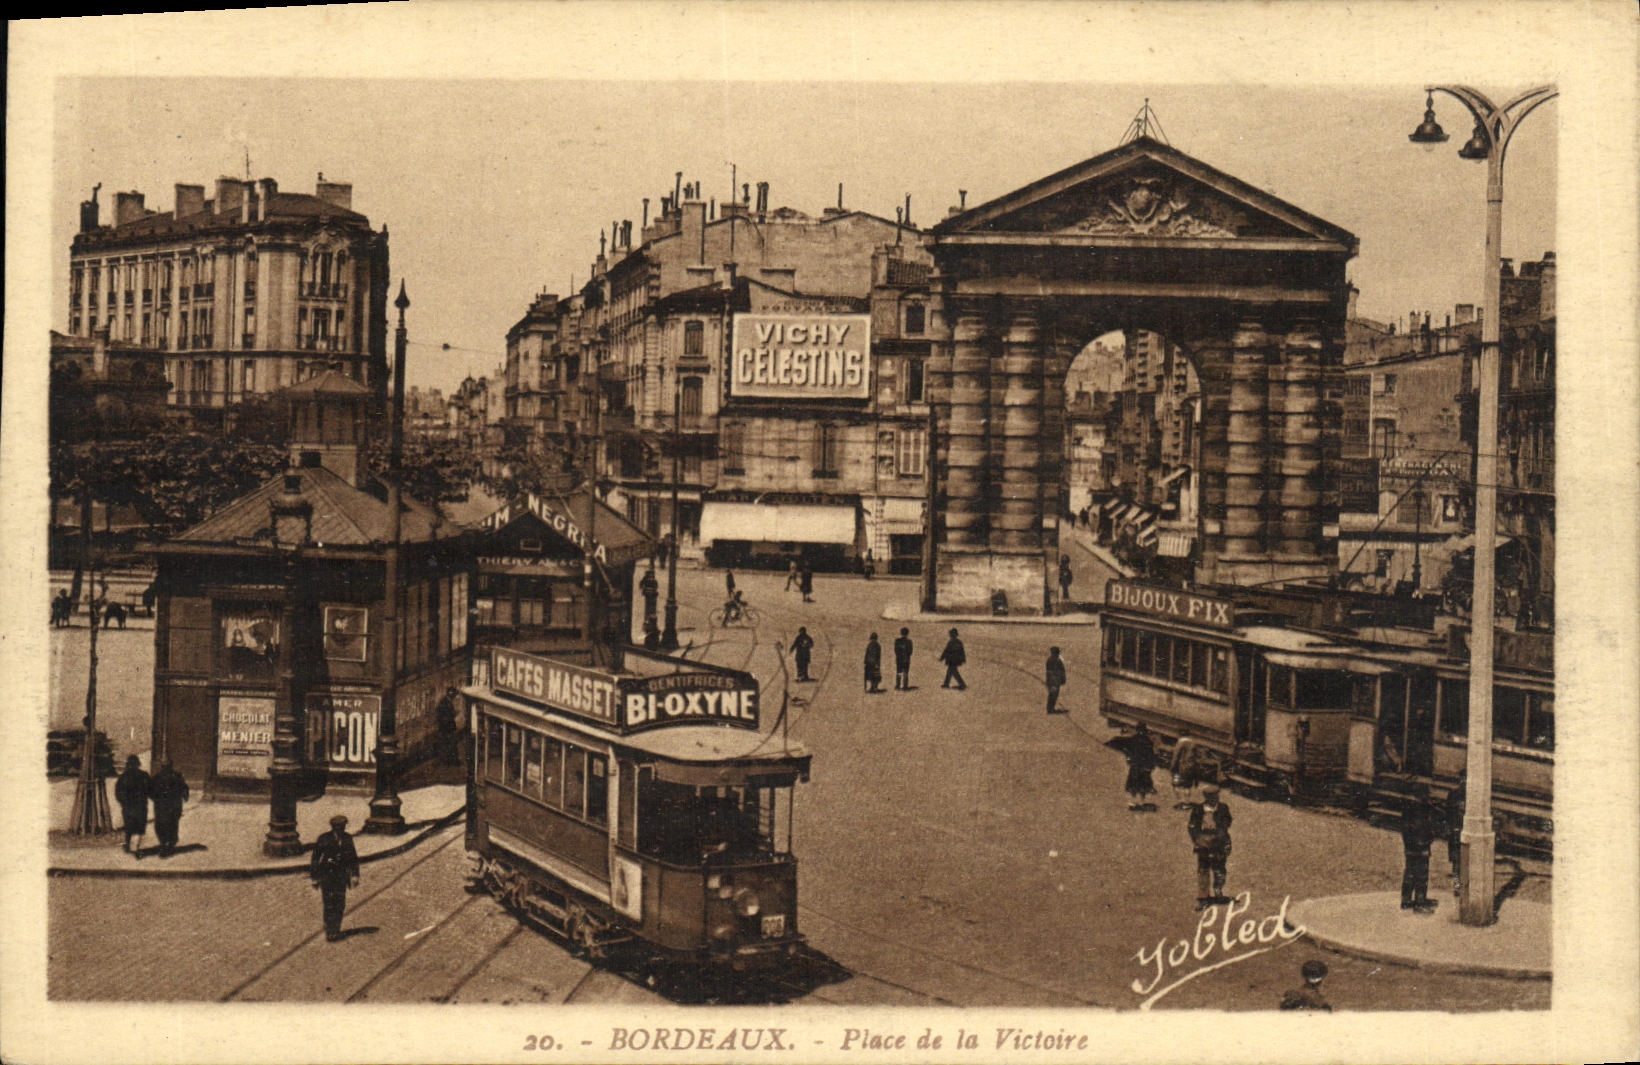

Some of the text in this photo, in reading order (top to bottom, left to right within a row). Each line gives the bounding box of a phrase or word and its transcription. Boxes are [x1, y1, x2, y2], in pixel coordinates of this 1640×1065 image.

[755, 322, 850, 346] VICHY
[739, 343, 863, 387] CÉLESTINS
[528, 491, 607, 564] NEGRIA
[1111, 584, 1229, 624] BIJOUX FIX
[548, 668, 613, 718] MASSET
[626, 690, 756, 726] BI-OXYNE
[221, 730, 271, 744] MENIER
[222, 712, 270, 724] CHOCOLAT
[309, 711, 378, 763] PICON
